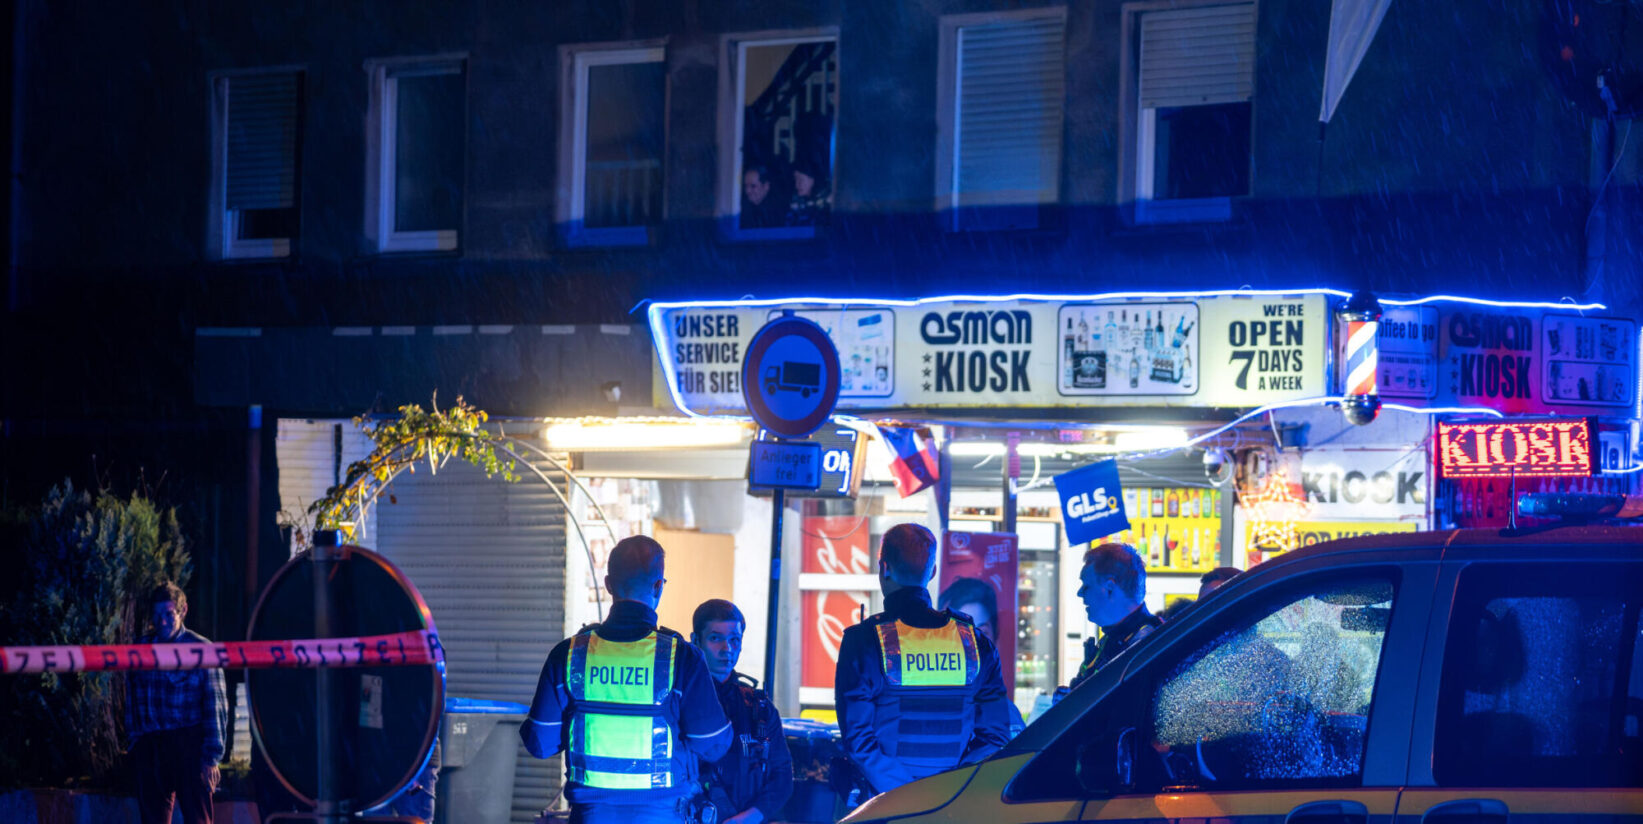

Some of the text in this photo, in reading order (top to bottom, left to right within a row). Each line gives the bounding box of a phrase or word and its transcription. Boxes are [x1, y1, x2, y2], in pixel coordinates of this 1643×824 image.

[1263, 304, 1304, 317] WE'RE
[675, 314, 739, 337] UNSER
[1229, 320, 1304, 347] OPEN
[1408, 321, 1418, 339] to
[1422, 324, 1434, 342] go
[676, 342, 740, 364] SERVICE
[677, 367, 739, 393] FÜR SIE!
[935, 350, 1032, 392] KIOSK
[1228, 349, 1304, 390] 7 DAYS
[1461, 354, 1532, 399] KIOSK
[1258, 376, 1303, 391] A WEEK
[1440, 423, 1590, 467] KIOSK
[776, 467, 797, 480] frei
[1067, 487, 1108, 519] GLS
[906, 652, 962, 672] POLIZEI
[590, 666, 649, 686] POLIZEI
